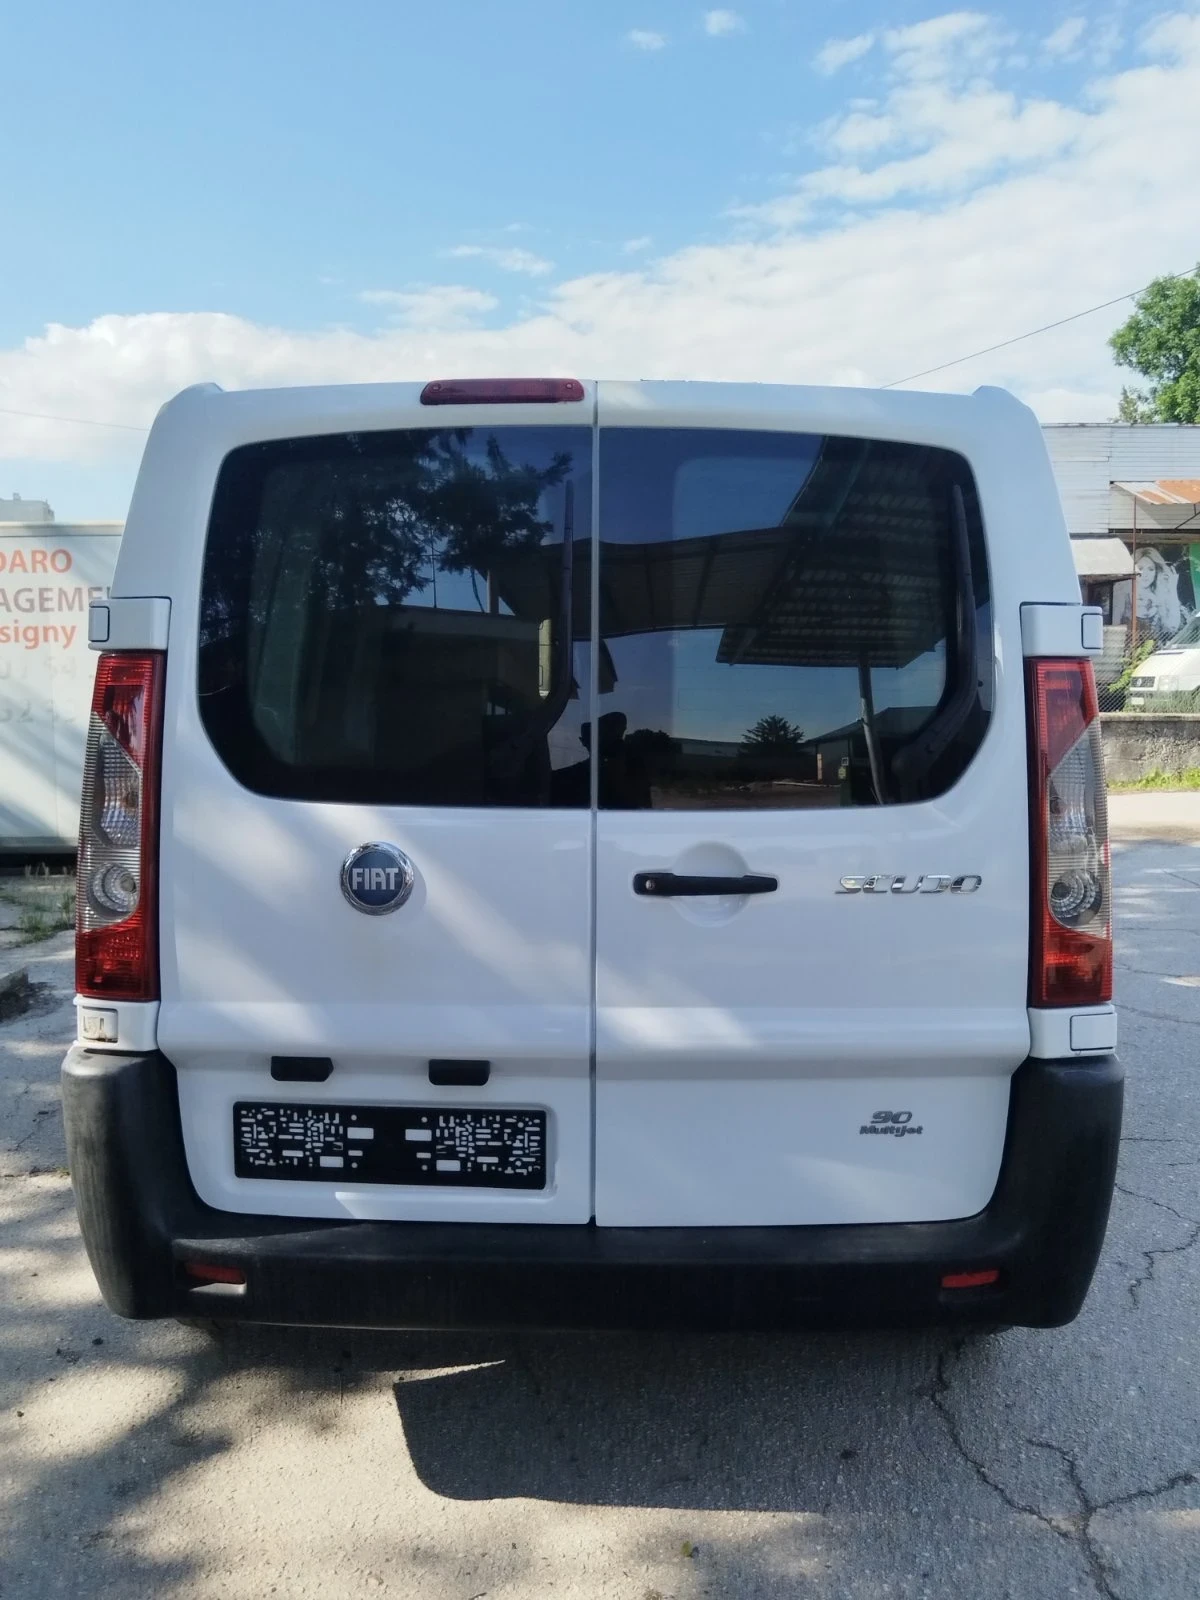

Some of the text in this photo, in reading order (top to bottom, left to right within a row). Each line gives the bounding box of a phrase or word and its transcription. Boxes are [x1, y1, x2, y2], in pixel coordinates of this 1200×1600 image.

[352, 867, 399, 891] FIAT
[835, 874, 983, 895] SCUDO
[870, 1110, 912, 1124] 90
